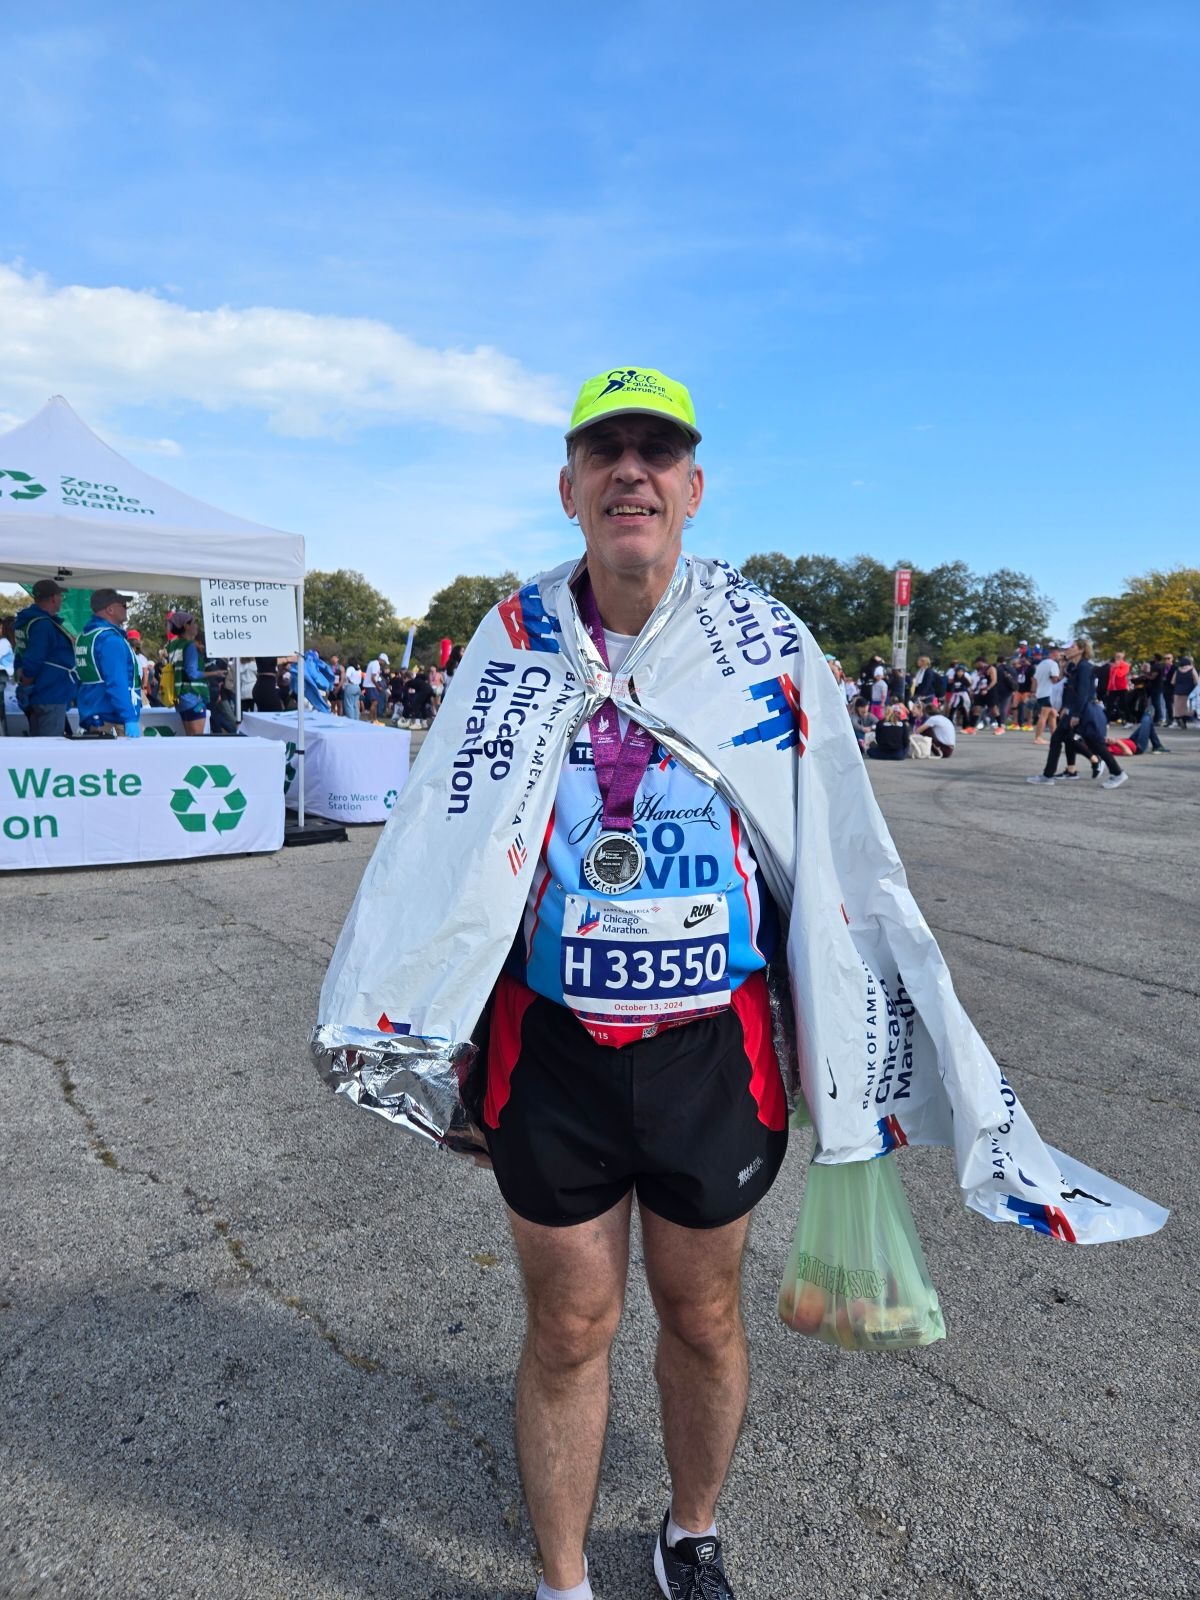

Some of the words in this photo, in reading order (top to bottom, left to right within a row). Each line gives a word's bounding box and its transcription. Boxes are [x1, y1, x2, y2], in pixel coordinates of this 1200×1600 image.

[60, 475, 119, 493] Zero
[61, 487, 141, 505] Waste
[62, 497, 155, 515] Station
[209, 579, 250, 590] Please
[210, 595, 225, 607] all
[229, 595, 270, 607] refuse
[212, 612, 248, 624] items
[251, 615, 267, 623] on
[213, 628, 252, 640] tables
[705, 626, 736, 678] BANK
[484, 666, 552, 781] Chicago
[575, 747, 593, 759] TE
[7, 767, 142, 799] Waste
[327, 792, 348, 801] Zero
[350, 793, 379, 801] Waste
[328, 801, 362, 811] Station
[579, 855, 719, 889] VID
[689, 903, 714, 918] RUN
[603, 914, 639, 926] Chicago
[602, 924, 648, 934] Marathon
[565, 946, 592, 987] H
[605, 943, 727, 990] 33550
[614, 1003, 646, 1011] October
[650, 1003, 662, 1012] 13,
[664, 1001, 683, 1010] 2024
[867, 1031, 877, 1055] OF
[893, 972, 916, 1101] Marath
[862, 1060, 877, 1110] BANK
